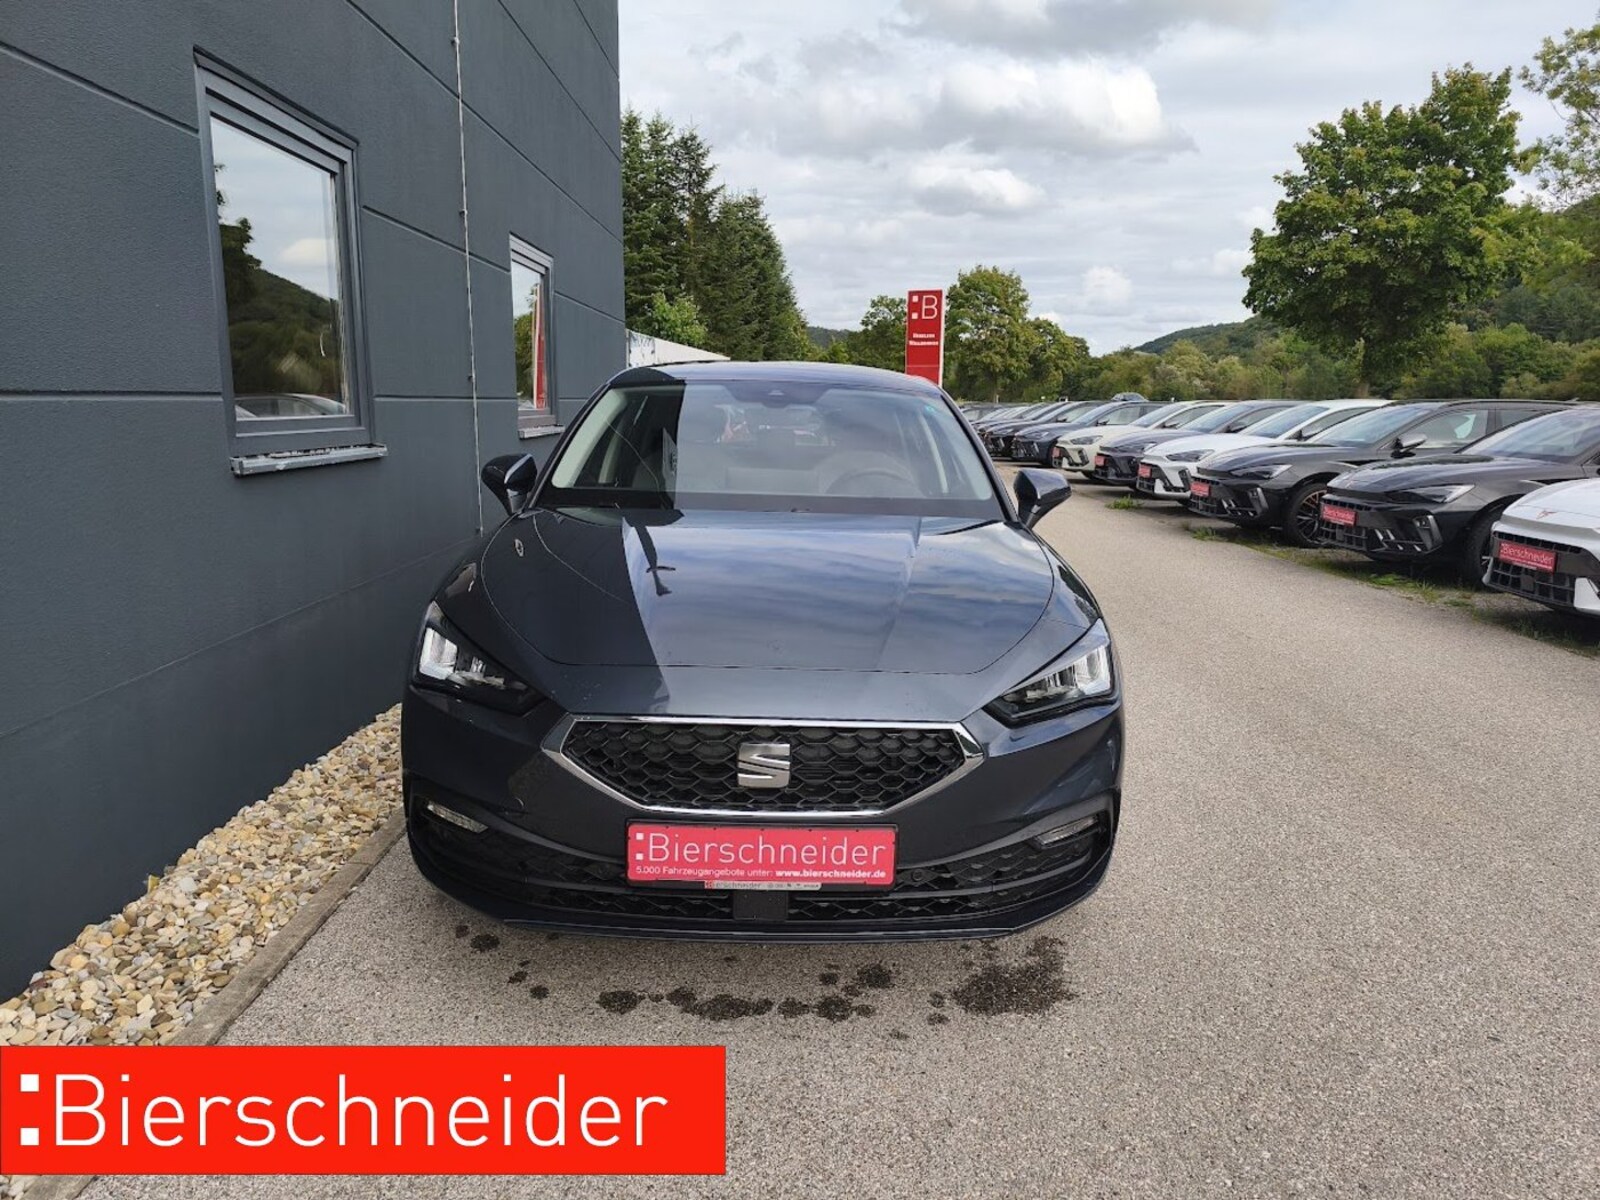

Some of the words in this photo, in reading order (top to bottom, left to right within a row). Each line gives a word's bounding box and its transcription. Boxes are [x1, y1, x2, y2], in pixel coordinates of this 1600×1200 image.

[636, 865, 661, 875] 5.000
[662, 866, 745, 878] Fahrzeugangebote
[747, 868, 774, 877] unter:
[775, 869, 887, 878] www.bierschneider.de
